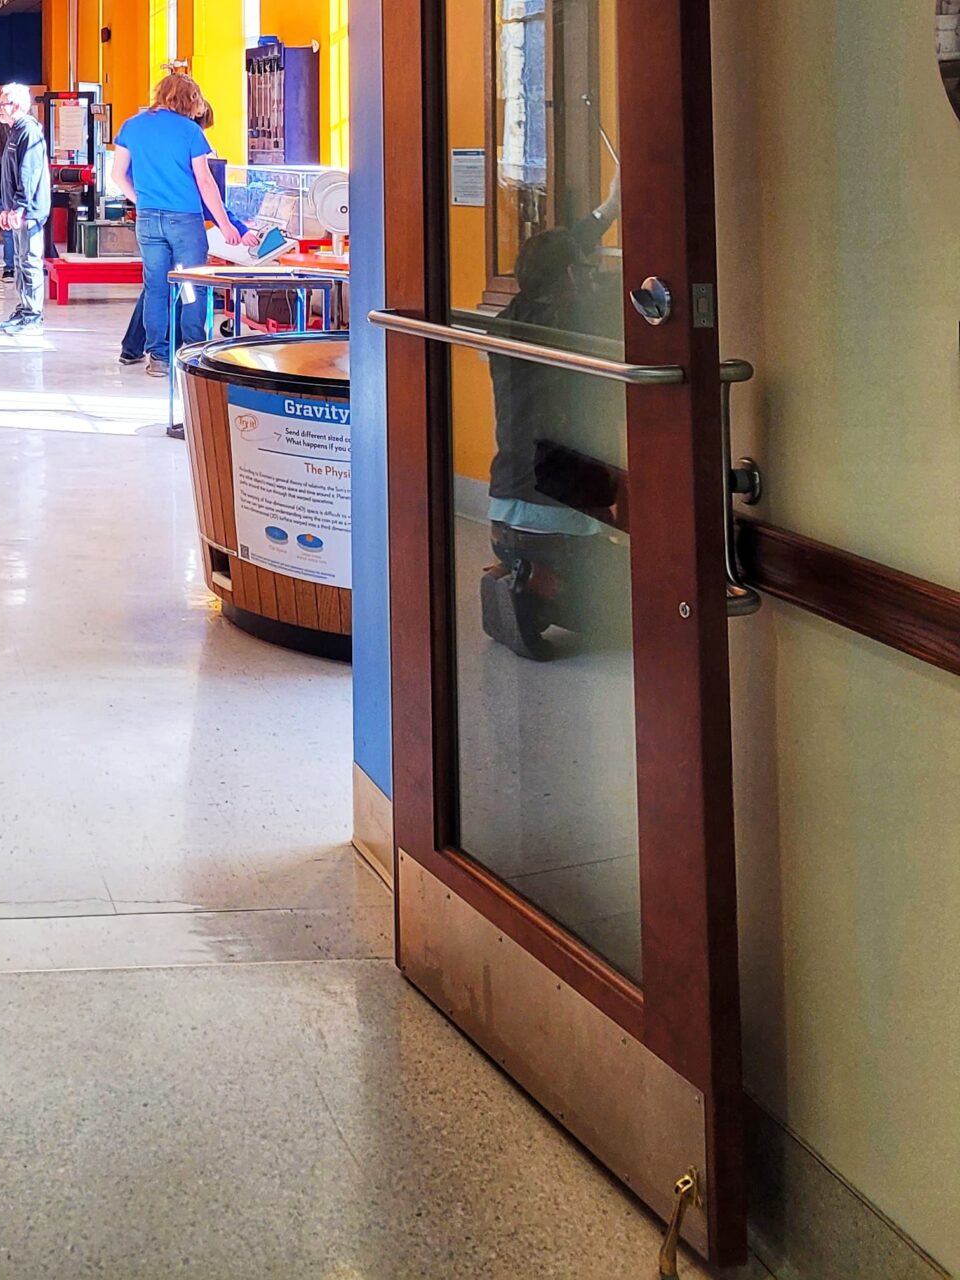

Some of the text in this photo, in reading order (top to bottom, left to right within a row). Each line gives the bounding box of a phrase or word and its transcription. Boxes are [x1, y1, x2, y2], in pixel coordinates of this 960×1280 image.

[284, 399, 350, 424] Gravity
[285, 427, 300, 437] Send
[301, 430, 327, 441] different
[327, 435, 344, 443] sized
[285, 436, 302, 446] What
[302, 439, 328, 450] happens
[334, 445, 347, 453] you
[304, 462, 351, 480] The Physi
